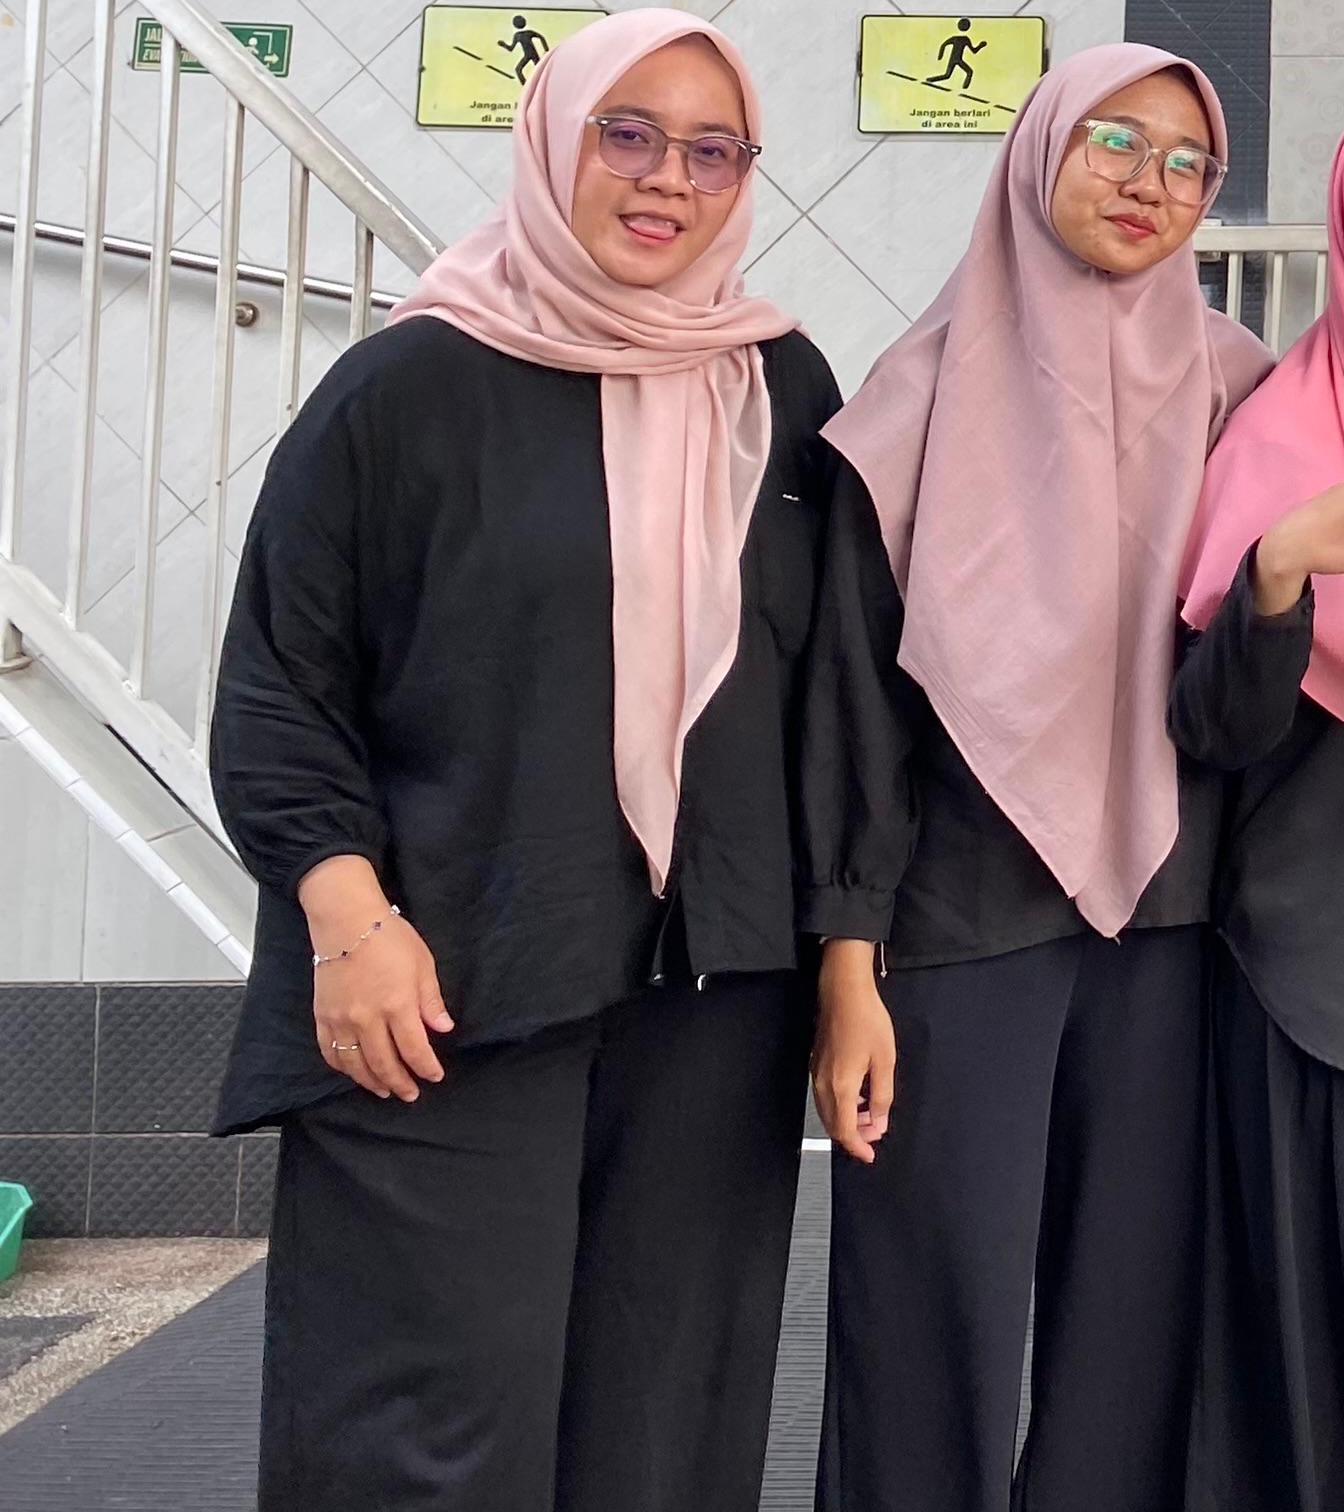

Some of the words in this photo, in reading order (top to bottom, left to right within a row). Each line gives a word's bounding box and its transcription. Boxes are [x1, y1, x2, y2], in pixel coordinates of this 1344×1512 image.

[469, 100, 511, 112] Jangan
[481, 114, 492, 123] di
[909, 108, 950, 119] Jangan
[953, 109, 991, 117] berlari
[921, 120, 932, 128] di
